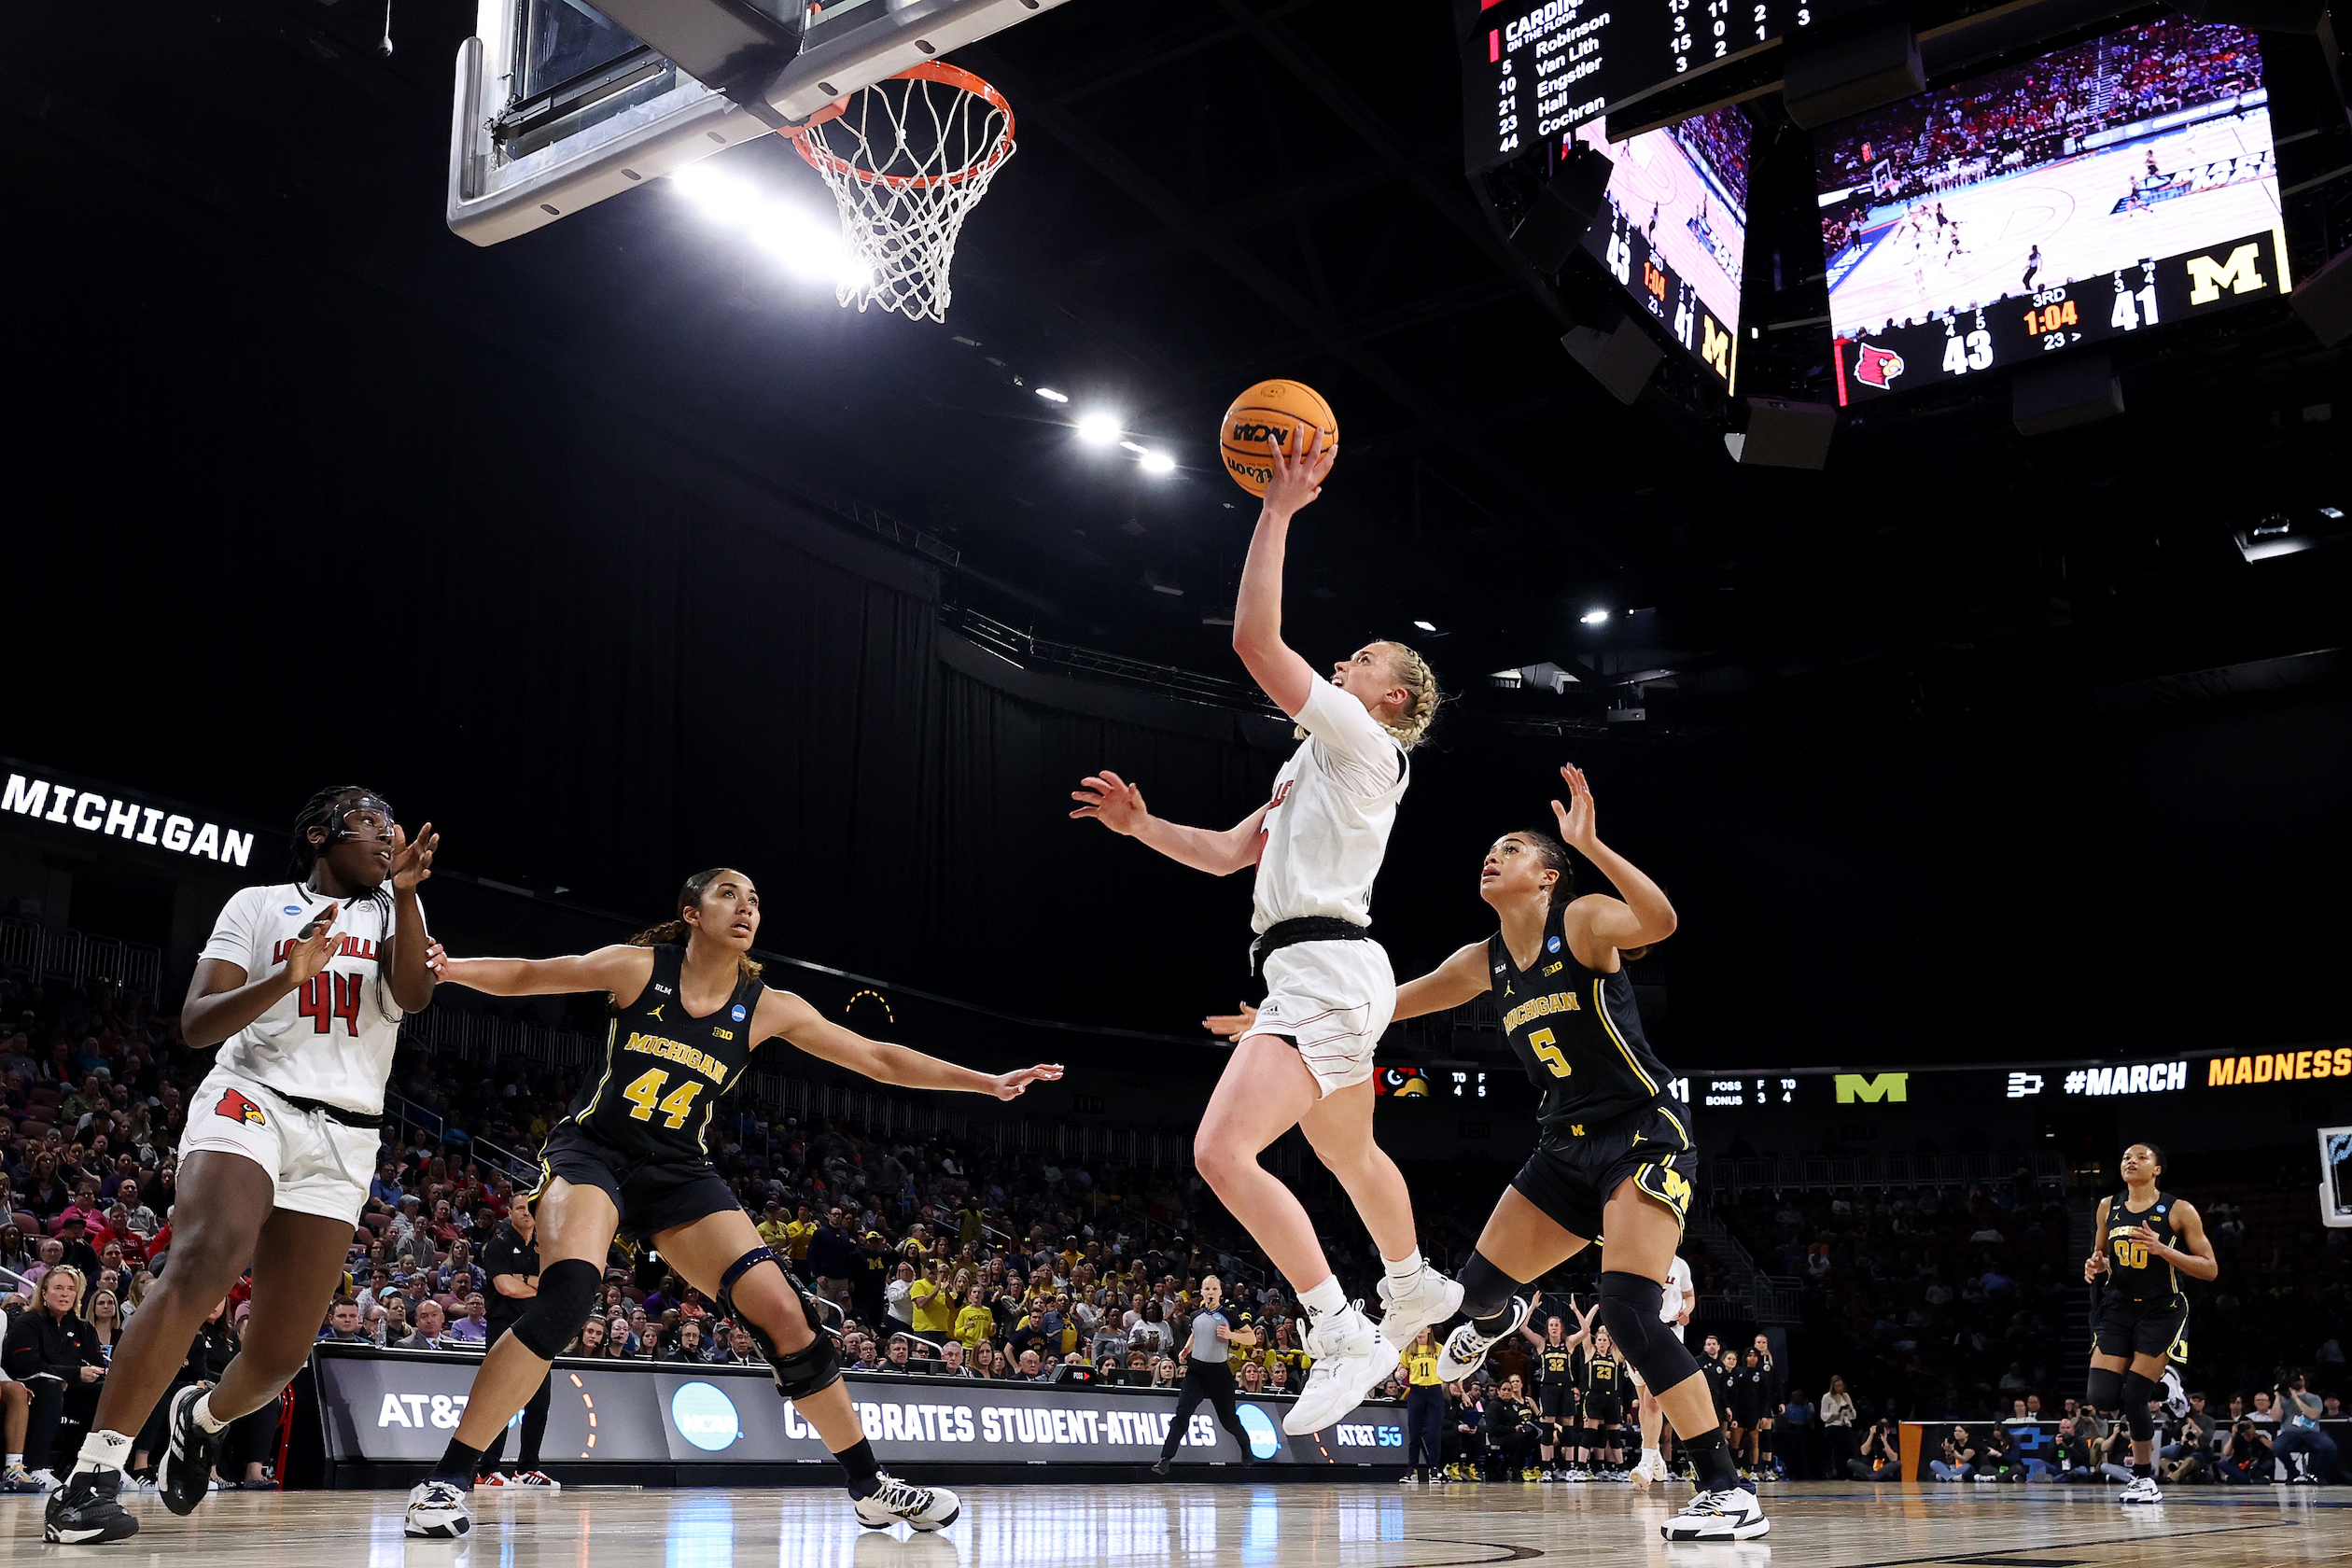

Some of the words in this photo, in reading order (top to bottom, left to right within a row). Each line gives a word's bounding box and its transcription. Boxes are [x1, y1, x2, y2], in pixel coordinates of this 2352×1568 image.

[1505, 0, 1585, 42] CARDIN
[1507, 37, 1522, 52] ON
[1523, 27, 1544, 44] THE
[1544, 9, 1577, 34] FLOOR
[1498, 95, 1516, 116] 21
[1536, 57, 1603, 98] Engstler
[1673, 16, 1686, 32] 3
[1708, 0, 1729, 18] 11
[1502, 59, 1512, 75] 5
[1535, 12, 1611, 58] Robinson
[1498, 77, 1517, 95] 10
[1535, 55, 1566, 77] Van
[1569, 37, 1600, 62] Lith
[1499, 115, 1519, 135] 23
[1537, 91, 1568, 118] Hall
[1671, 34, 1692, 54] 15
[1713, 20, 1726, 36] 0
[1754, 4, 1766, 21] 2
[1499, 133, 1519, 152] 44
[1538, 96, 1605, 135] Cochran
[1676, 56, 1687, 73] 3
[1715, 40, 1727, 58] 2
[1756, 25, 1766, 41] 1
[1798, 8, 1811, 25] 3
[1606, 231, 1631, 286] 43
[1644, 261, 1666, 301] 1:04
[2033, 287, 2066, 308] 3RD
[2110, 284, 2160, 331] 41
[2186, 242, 2265, 306] M
[2114, 279, 2124, 293] 3
[2144, 271, 2155, 284] 4
[1648, 295, 1659, 315] 23
[2023, 300, 2079, 336] 1:04
[1673, 301, 1694, 351] 41
[1945, 325, 1955, 337] 4
[1976, 316, 1986, 329] 5
[2043, 332, 2066, 351] 23
[1942, 329, 1995, 375] 43
[1226, 455, 1273, 484] ilson
[0, 773, 255, 867] MICHIGAN
[299, 970, 363, 1038] 44
[654, 983, 673, 995] BLM
[1503, 991, 1581, 1037] MICHIGAN
[623, 1031, 728, 1085] MICHIGAN
[1528, 1027, 1572, 1078] 5
[1451, 1072, 1466, 1083] TO
[1477, 1073, 1486, 1083] F
[1712, 1081, 1743, 1091] POSS
[1757, 1080, 1765, 1090] F
[1781, 1079, 1796, 1089] TO
[1834, 1072, 1909, 1103] M
[2064, 1061, 2188, 1096] #MARCH
[2208, 1047, 2352, 1086] MADNESS
[623, 1067, 705, 1129] 44
[1454, 1085, 1463, 1096] 4
[1477, 1085, 1486, 1097] 5
[1705, 1096, 1743, 1106] BONUS
[1757, 1092, 1766, 1103] 3
[1782, 1091, 1791, 1102] 4
[1571, 1125, 1585, 1137] M
[1662, 1167, 1691, 1214] M
[867, 1256, 885, 1270] M
[2114, 1239, 2148, 1268] 00
[1276, 1353, 1295, 1365] M
[1420, 1362, 1430, 1377] 11
[1548, 1358, 1565, 1372] 32
[1596, 1365, 1613, 1379] 23
[1336, 1423, 1377, 1447] AT&T
[1378, 1425, 1404, 1448] 5G
